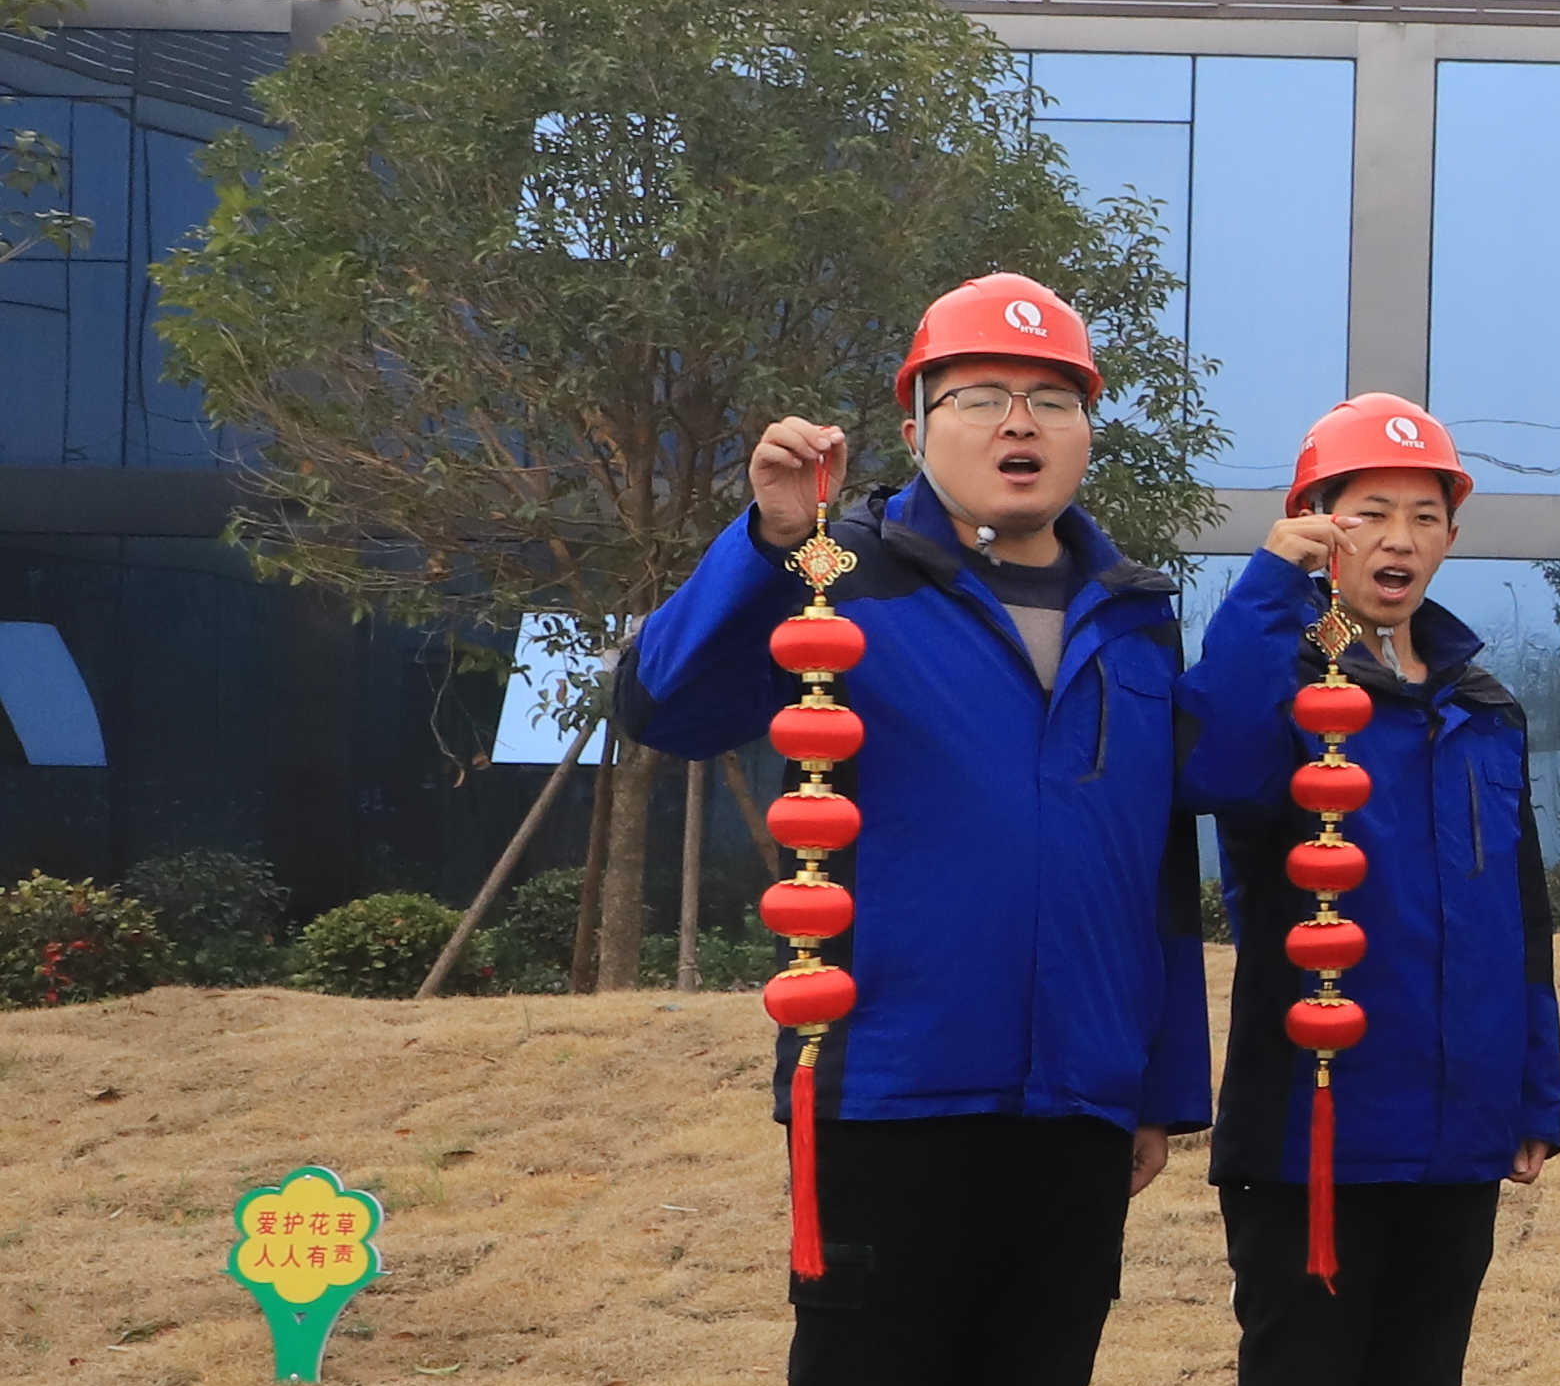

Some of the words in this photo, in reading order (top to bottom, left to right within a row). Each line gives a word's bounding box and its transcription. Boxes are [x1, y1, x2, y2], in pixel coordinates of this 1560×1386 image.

[1020, 324, 1048, 338] HYSZ
[1401, 439, 1426, 449] HYSZ
[256, 1211, 356, 1236] 爱护花草
[254, 1243, 354, 1269] 人人有责
